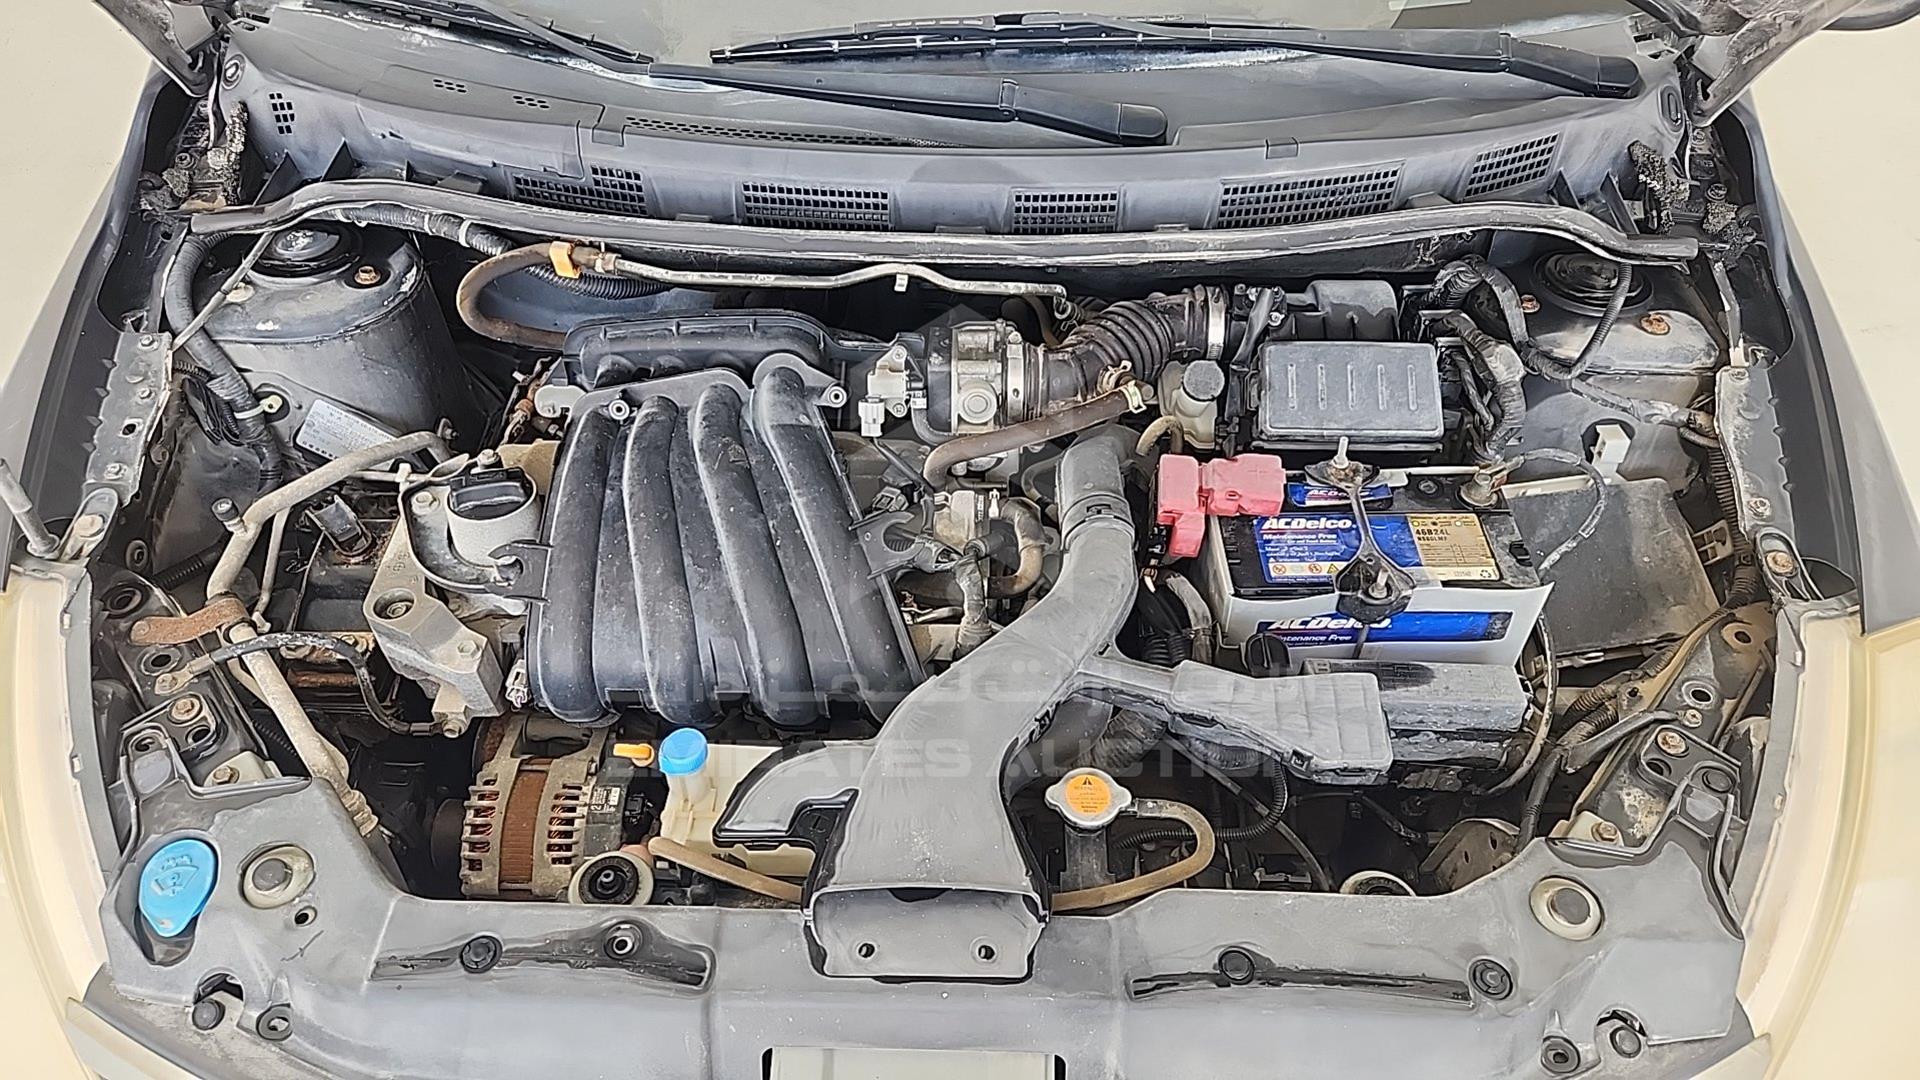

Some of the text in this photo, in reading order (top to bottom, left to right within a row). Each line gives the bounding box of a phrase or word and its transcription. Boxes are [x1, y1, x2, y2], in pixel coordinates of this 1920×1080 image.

[1261, 517, 1354, 530] ACDelco
[1262, 533, 1338, 541] Maintenance Free
[1328, 634, 1353, 642] Free
